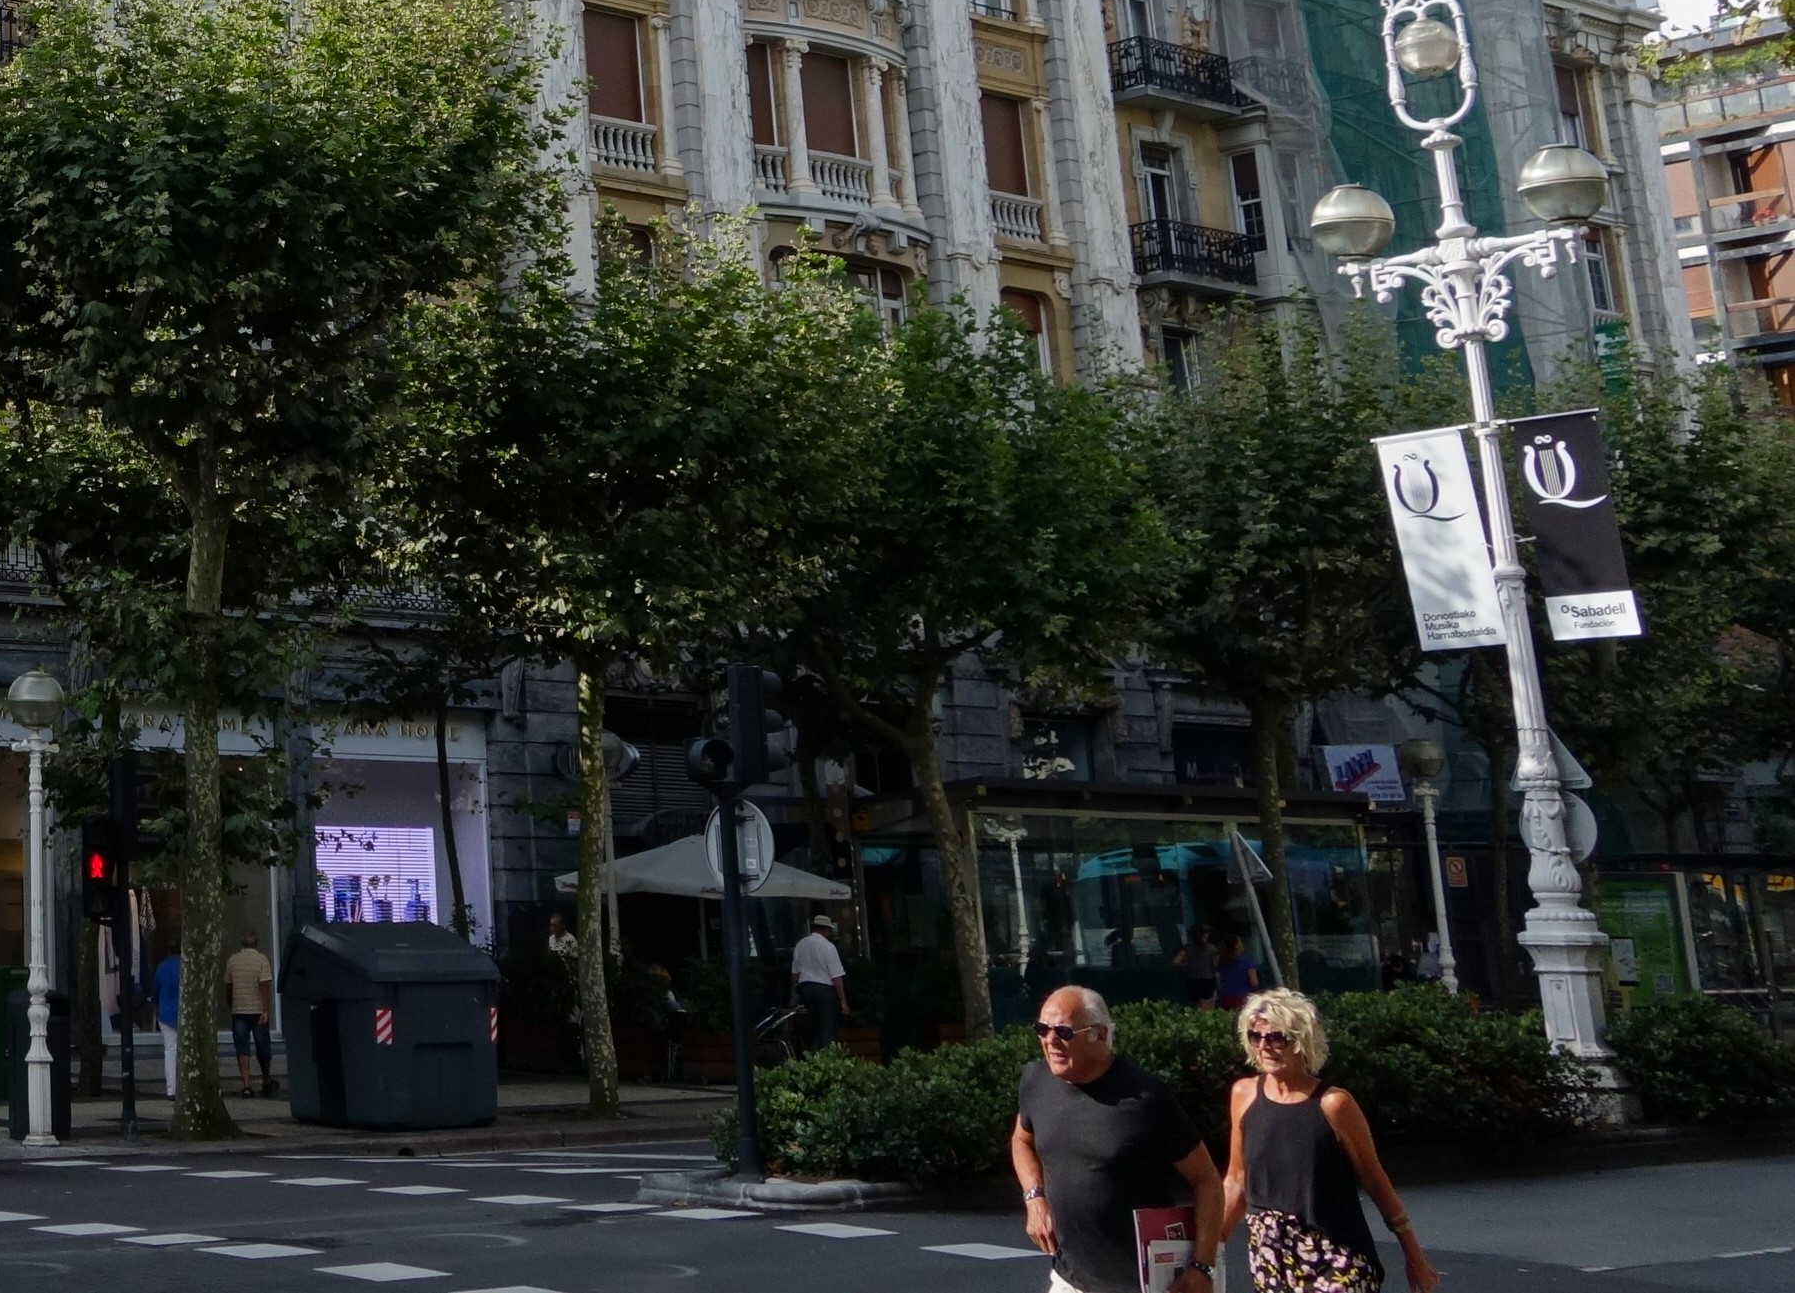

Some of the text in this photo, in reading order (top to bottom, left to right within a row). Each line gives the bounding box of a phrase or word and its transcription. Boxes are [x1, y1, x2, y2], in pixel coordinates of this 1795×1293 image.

[1423, 610, 1476, 622] Donostiako
[1425, 621, 1460, 631] Musika
[123, 712, 172, 730] ARA
